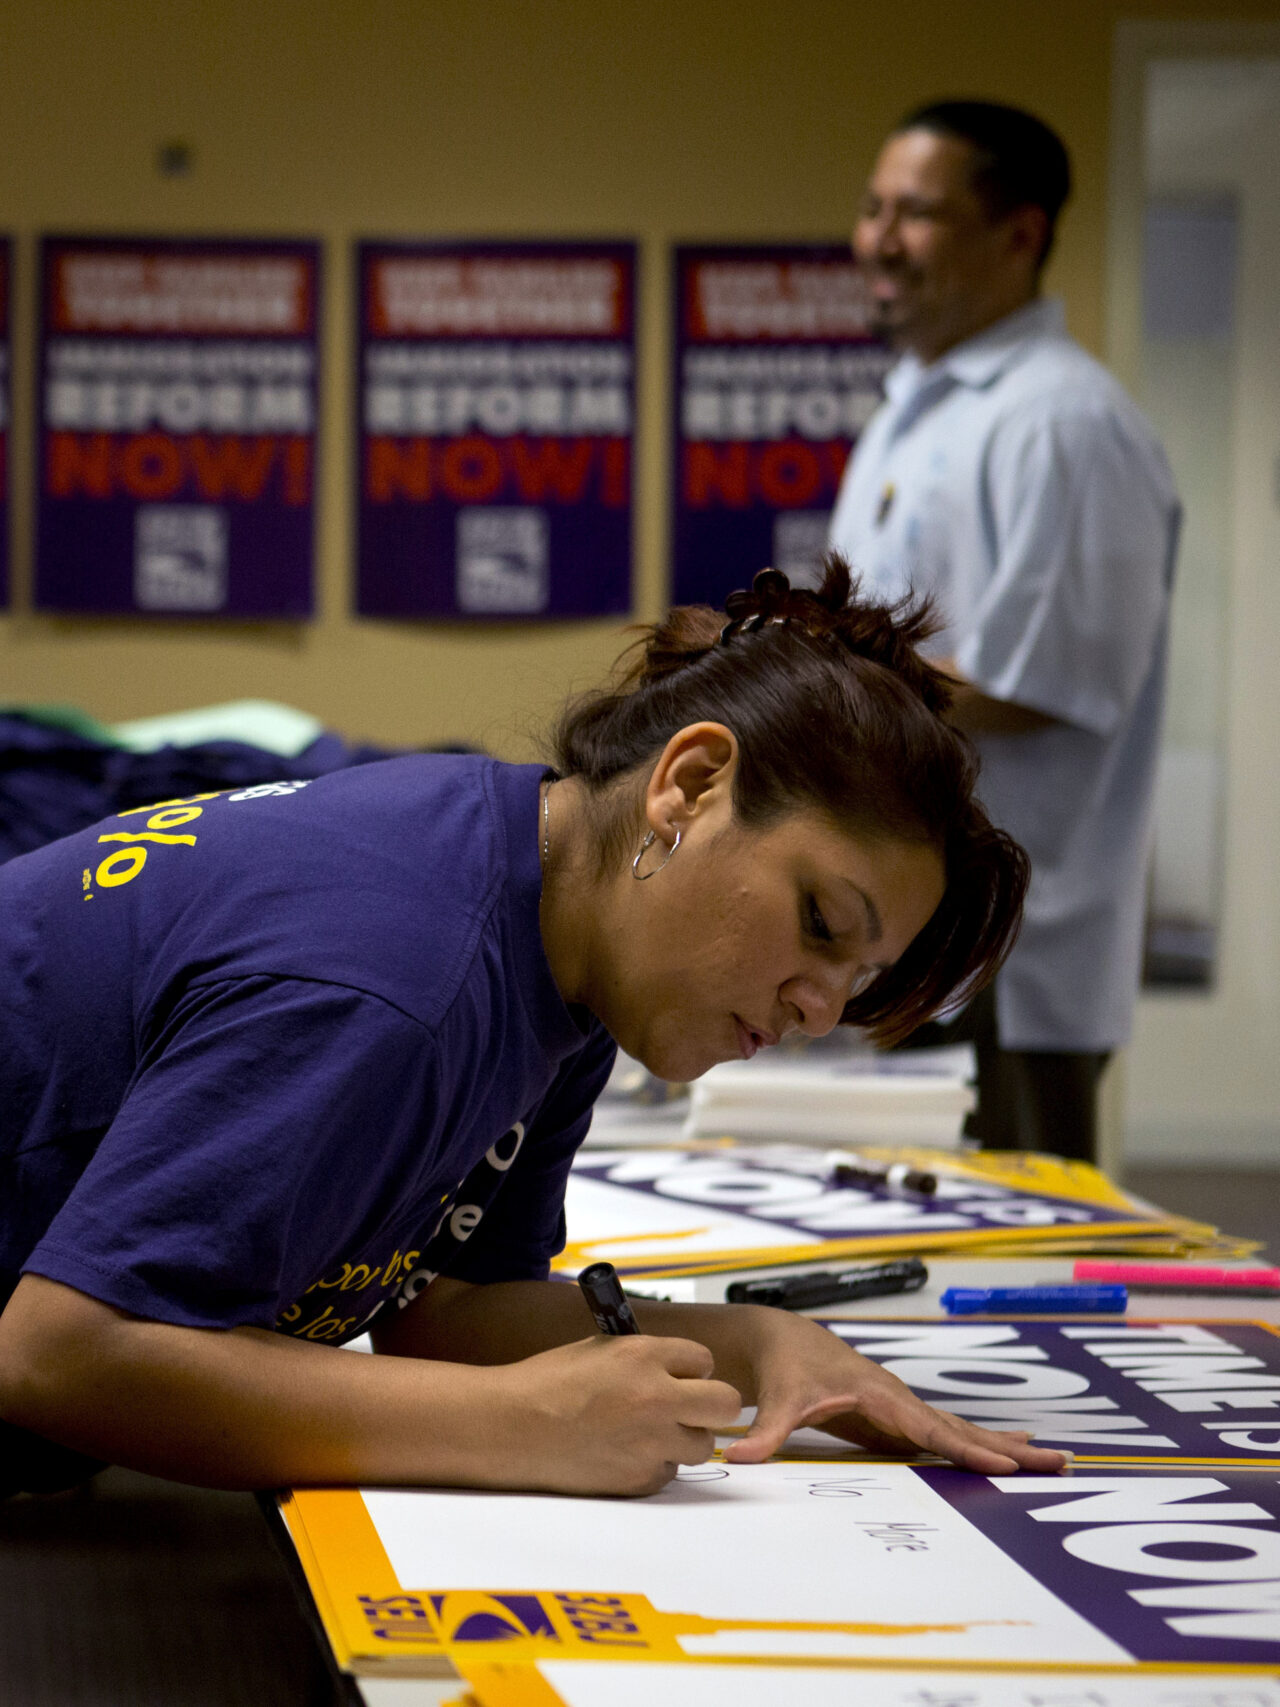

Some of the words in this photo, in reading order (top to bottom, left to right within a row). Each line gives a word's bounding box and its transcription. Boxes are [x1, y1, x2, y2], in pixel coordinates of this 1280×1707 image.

[49, 381, 311, 436] REFORM
[367, 383, 629, 438] REFORM
[48, 436, 311, 506] NOW!
[367, 438, 629, 508] NOW!
[828, 1324, 1181, 1449] NOW
[1059, 1325, 1280, 1413] TIME
[783, 1477, 891, 1498] No
[854, 1521, 940, 1552] More
[356, 1594, 441, 1645] SEIU
[552, 1593, 650, 1649] 32BJ
